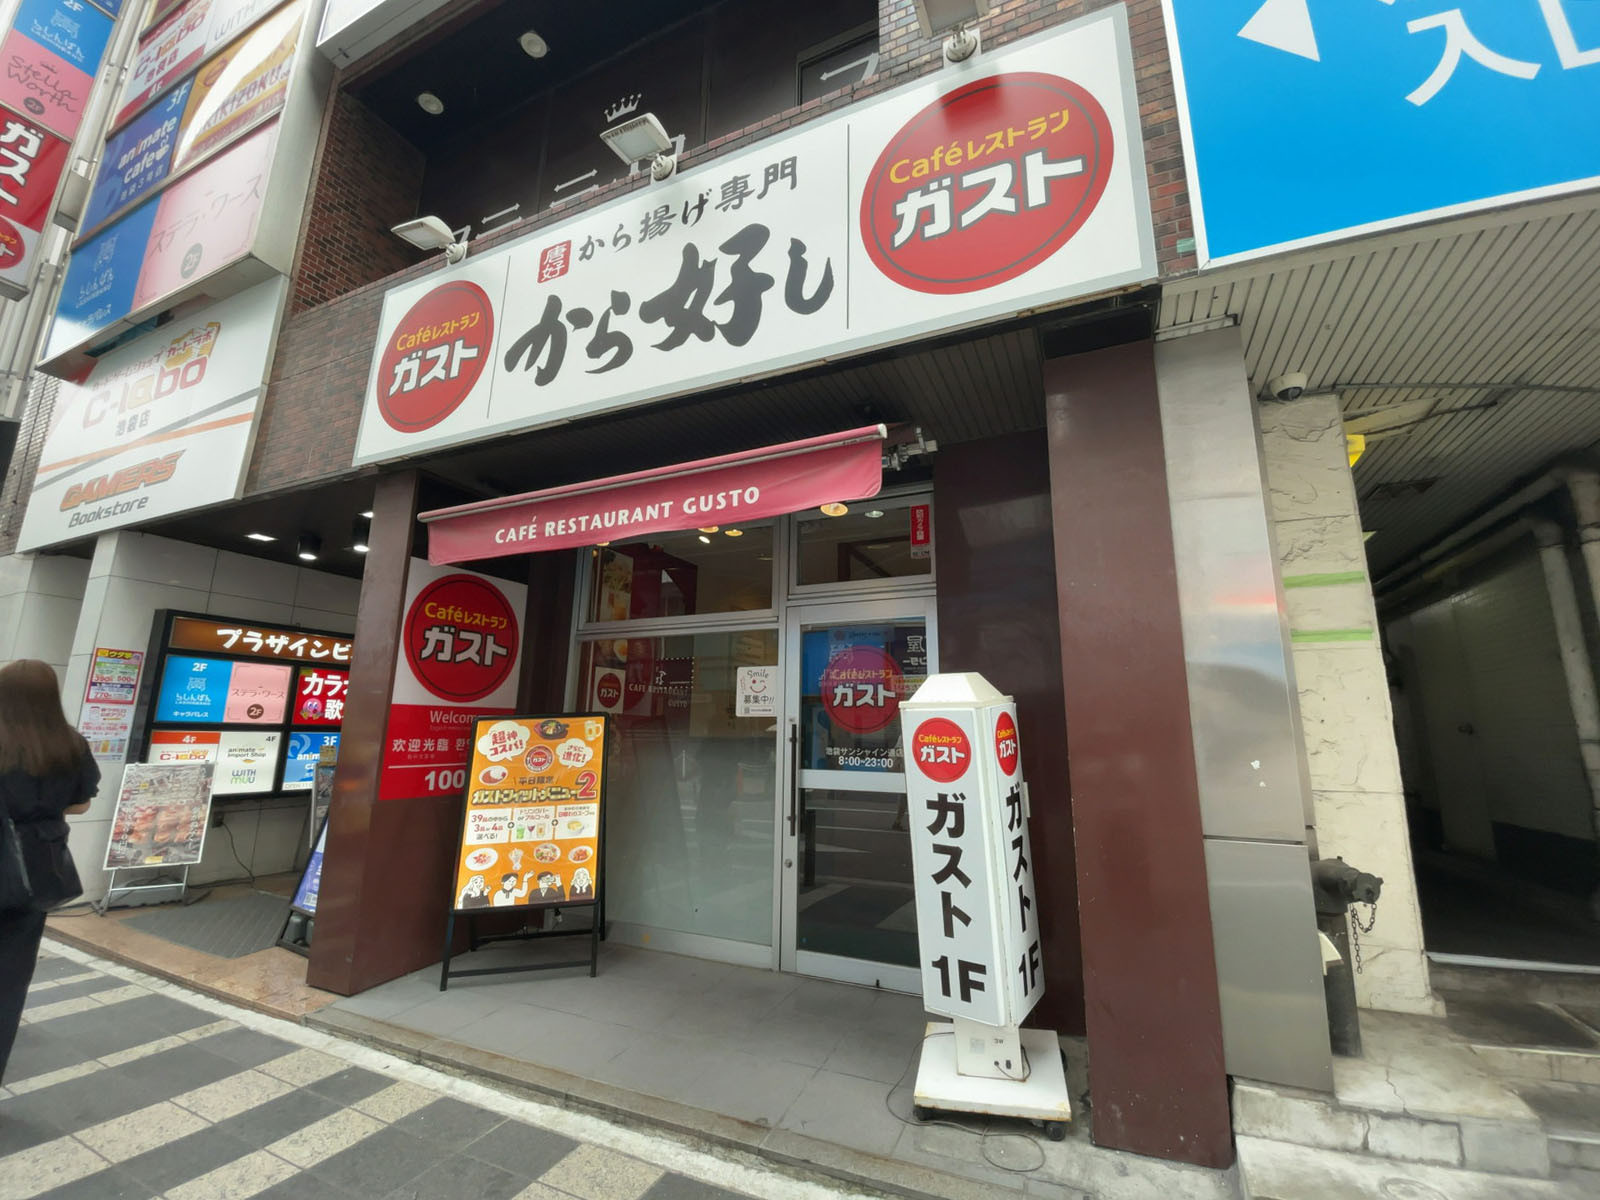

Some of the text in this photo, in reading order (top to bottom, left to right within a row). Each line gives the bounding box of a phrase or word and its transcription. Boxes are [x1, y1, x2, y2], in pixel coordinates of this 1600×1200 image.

[166, 82, 189, 112] 3F
[118, 117, 177, 170] animate
[578, 156, 798, 262] から揚げ専門
[893, 150, 1084, 249] ガスト
[542, 244, 567, 281] 唐好
[504, 223, 834, 386] から好し
[388, 341, 480, 396] ガスト
[60, 449, 187, 512] GAMERS
[68, 496, 149, 528] Bookstore
[495, 486, 760, 544] CAFÉ RESTAURANT GUSTO
[420, 625, 508, 666] ガスト
[192, 662, 208, 672] 2F
[747, 668, 769, 678] Smile
[249, 706, 263, 716] 2F
[600, 688, 619, 698] ガスト
[833, 683, 896, 707] ガスト
[182, 735, 197, 744] 4F
[323, 736, 338, 746] 3F
[920, 744, 966, 764] ガスト
[1000, 739, 1016, 758] ガスト
[926, 792, 972, 939] ガスト
[1006, 782, 1032, 934] ガスト
[931, 954, 987, 1003] 1F
[1018, 940, 1039, 998] 1F
